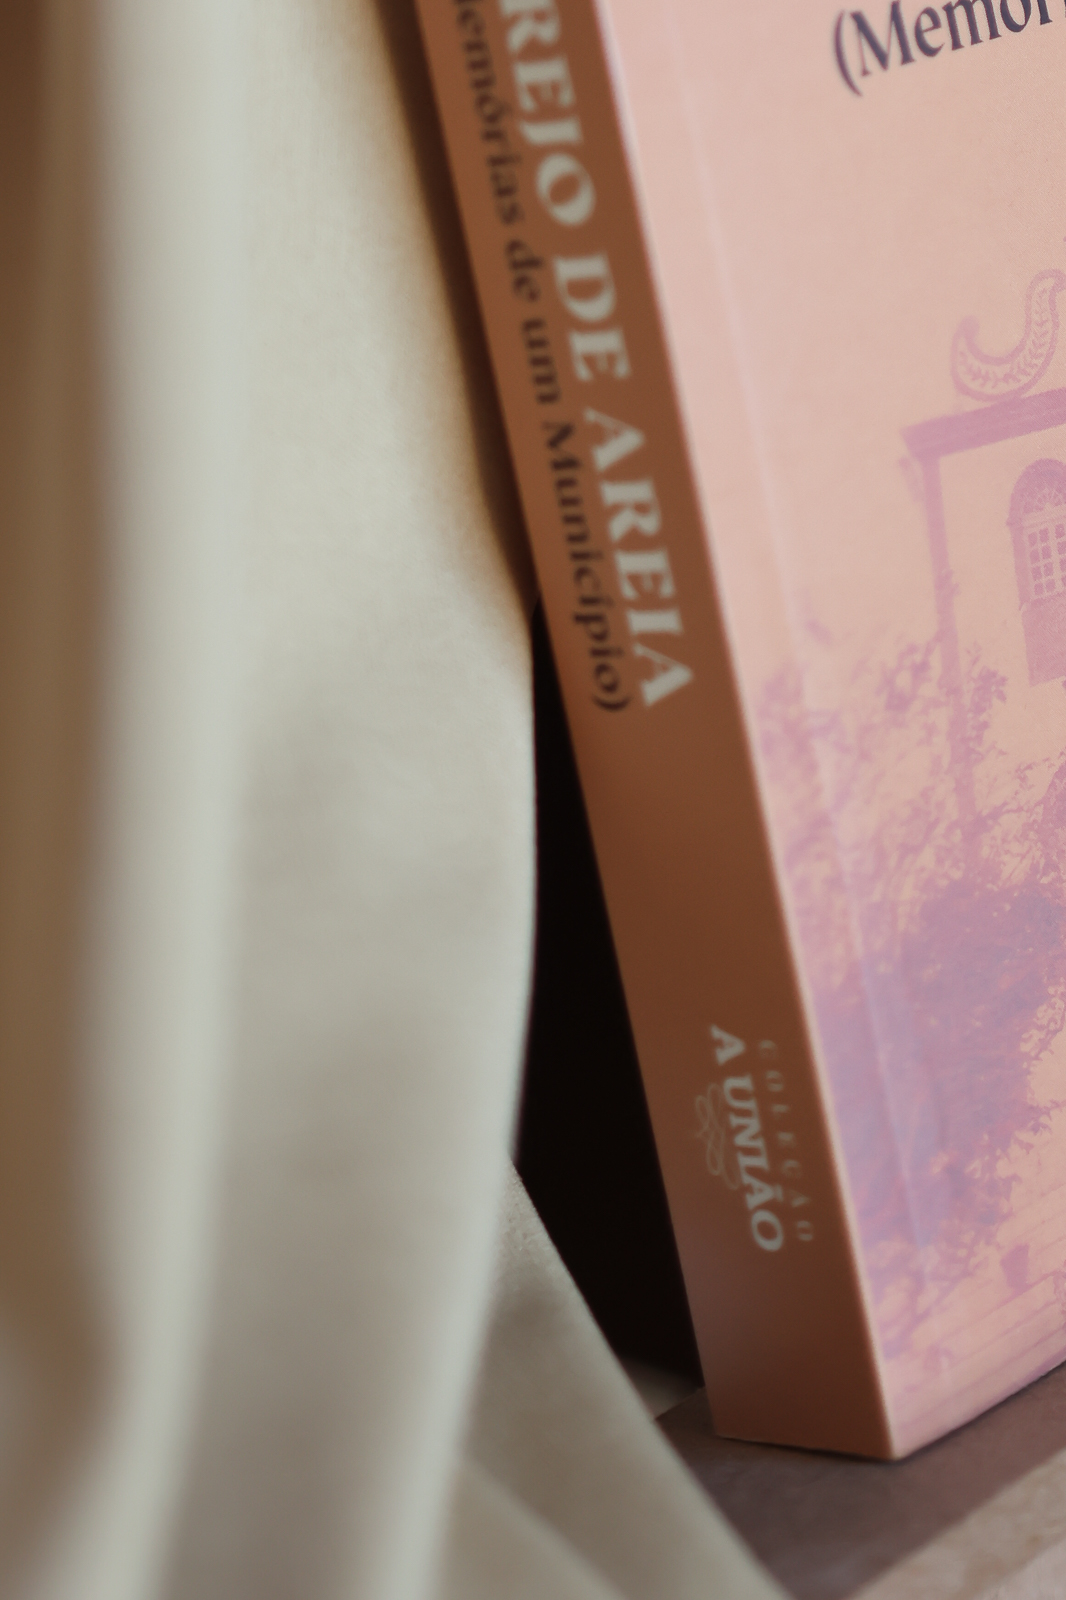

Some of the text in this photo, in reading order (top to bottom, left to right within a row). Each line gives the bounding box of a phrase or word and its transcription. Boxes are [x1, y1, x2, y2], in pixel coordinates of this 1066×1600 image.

[504, 234, 543, 301] de
[553, 253, 629, 383] DE
[520, 317, 562, 404] um
[541, 417, 632, 713] Município)
[586, 406, 694, 707] AREIA
[710, 1024, 784, 1251] A UNIÃO
